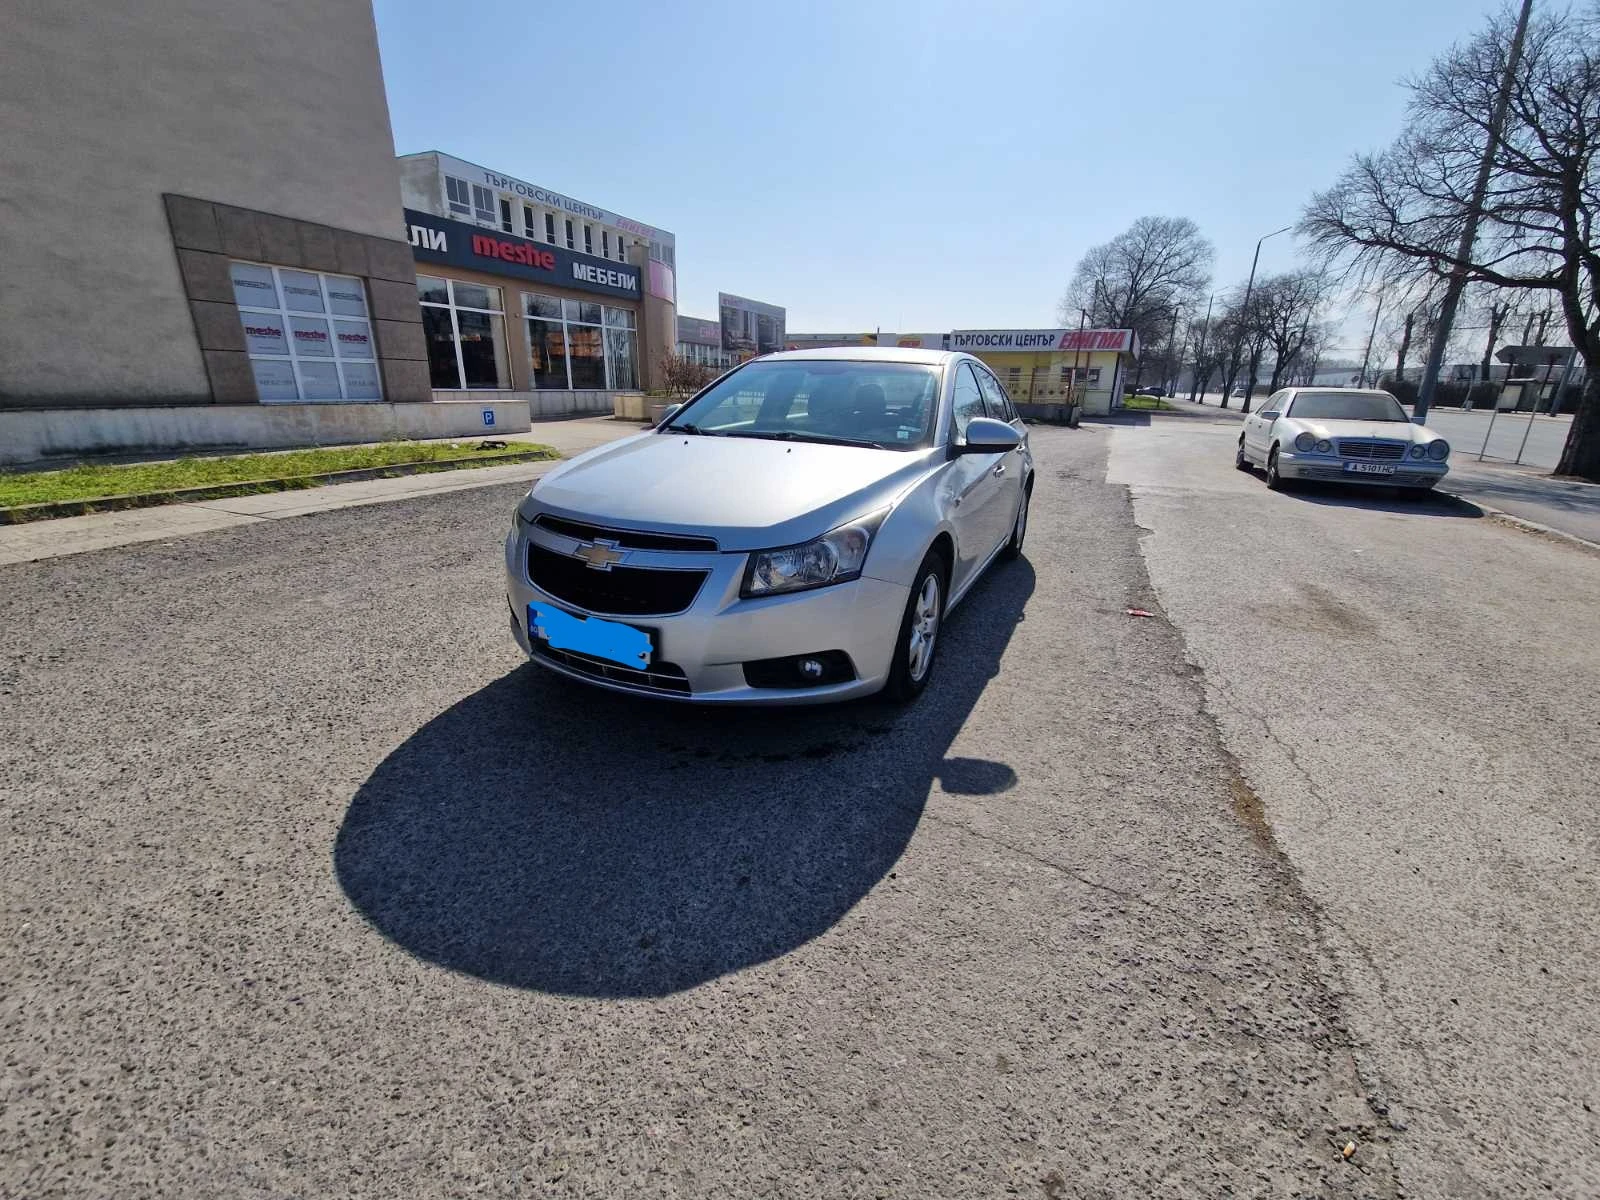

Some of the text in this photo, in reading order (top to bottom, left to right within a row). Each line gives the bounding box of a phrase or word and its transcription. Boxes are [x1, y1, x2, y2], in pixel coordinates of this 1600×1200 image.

[484, 172, 561, 207] ТЪРГОВСКИ
[564, 200, 604, 220] ЦЕНТЪР
[407, 224, 448, 252] ЛИ
[472, 234, 556, 269] meshe
[572, 262, 636, 291] МЕБЕЛИ
[954, 334, 1012, 346] ТЪРГОВСКИ
[1015, 334, 1055, 347] ЦЕНТЪР
